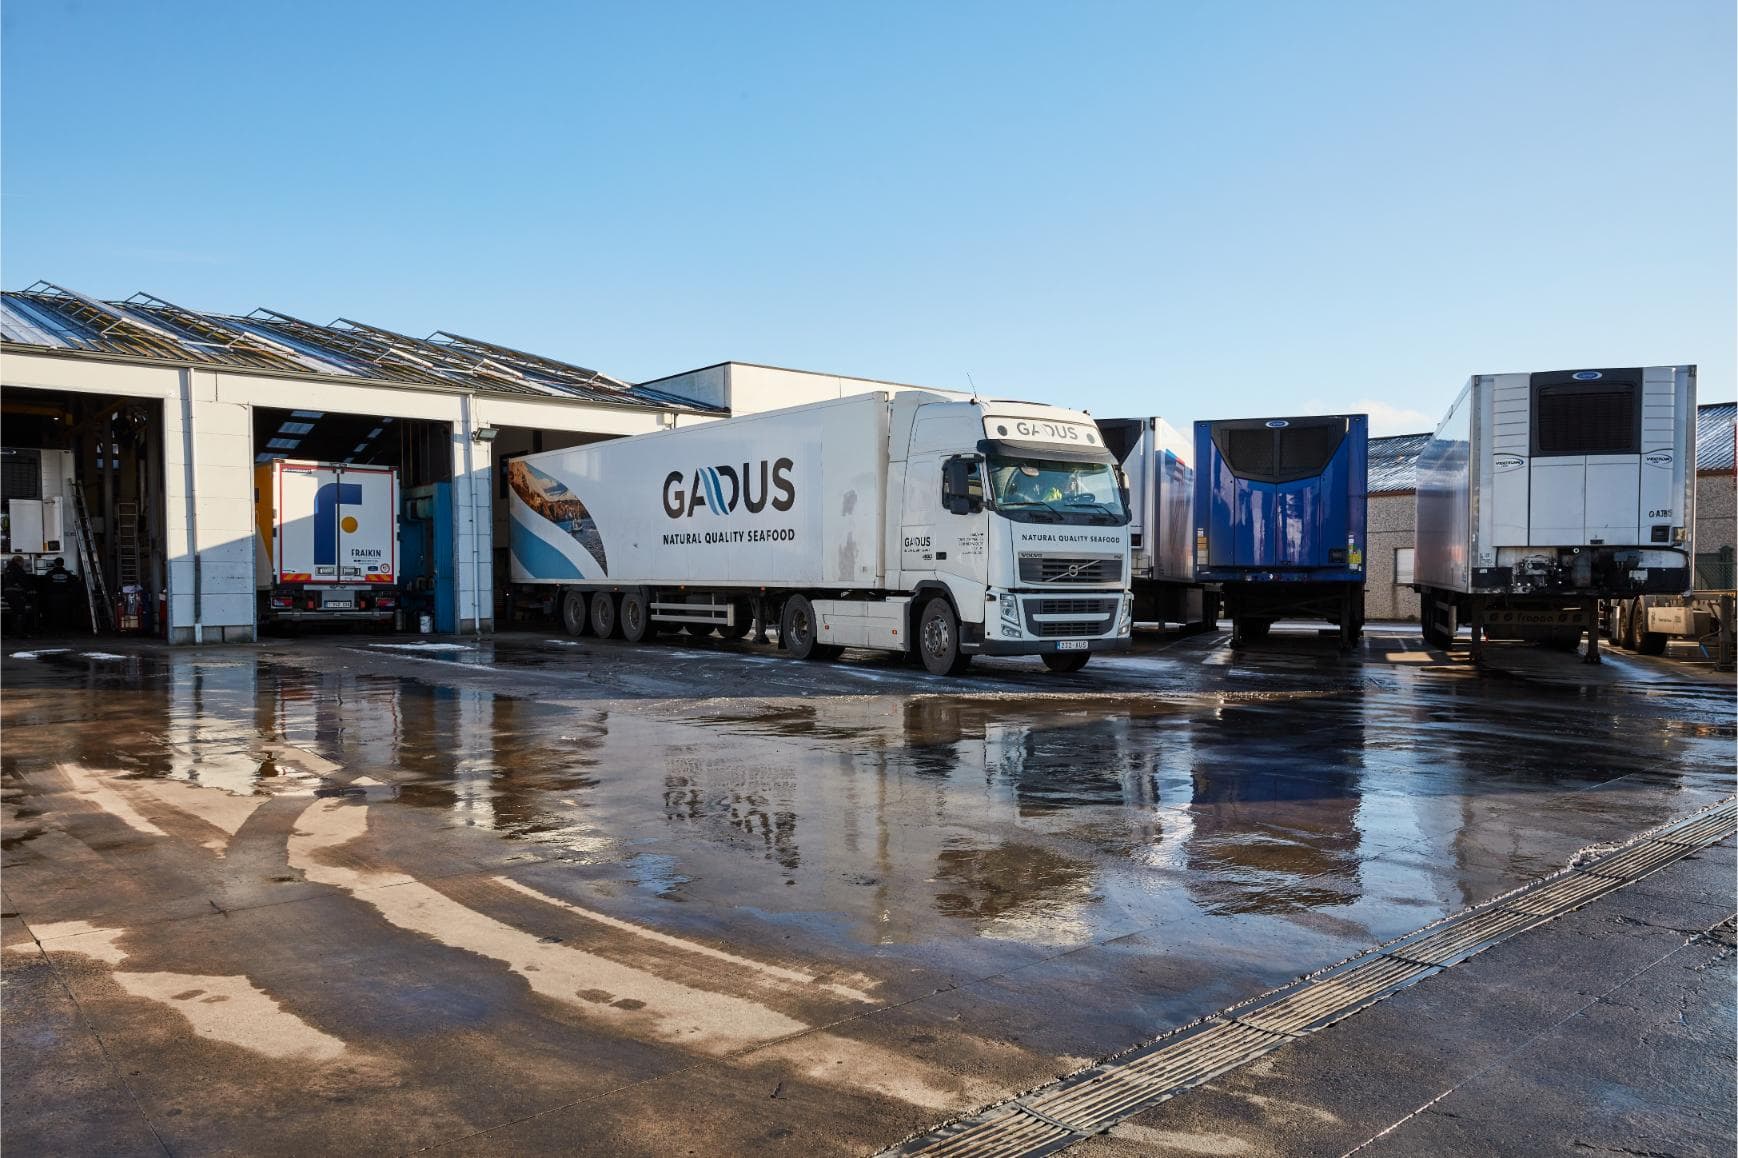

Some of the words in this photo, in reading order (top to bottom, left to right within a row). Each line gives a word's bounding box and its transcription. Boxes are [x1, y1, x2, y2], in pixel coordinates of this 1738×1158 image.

[663, 457, 796, 519] GADUS
[663, 533, 702, 545] NATURAL
[705, 531, 744, 544] QUALITY
[747, 528, 796, 542] SEAFOOD
[1022, 534, 1056, 542] NATURAL
[1058, 535, 1088, 543] QUALITY
[1090, 536, 1120, 544] SEAFOOD
[351, 549, 382, 558] FRAIKIN
